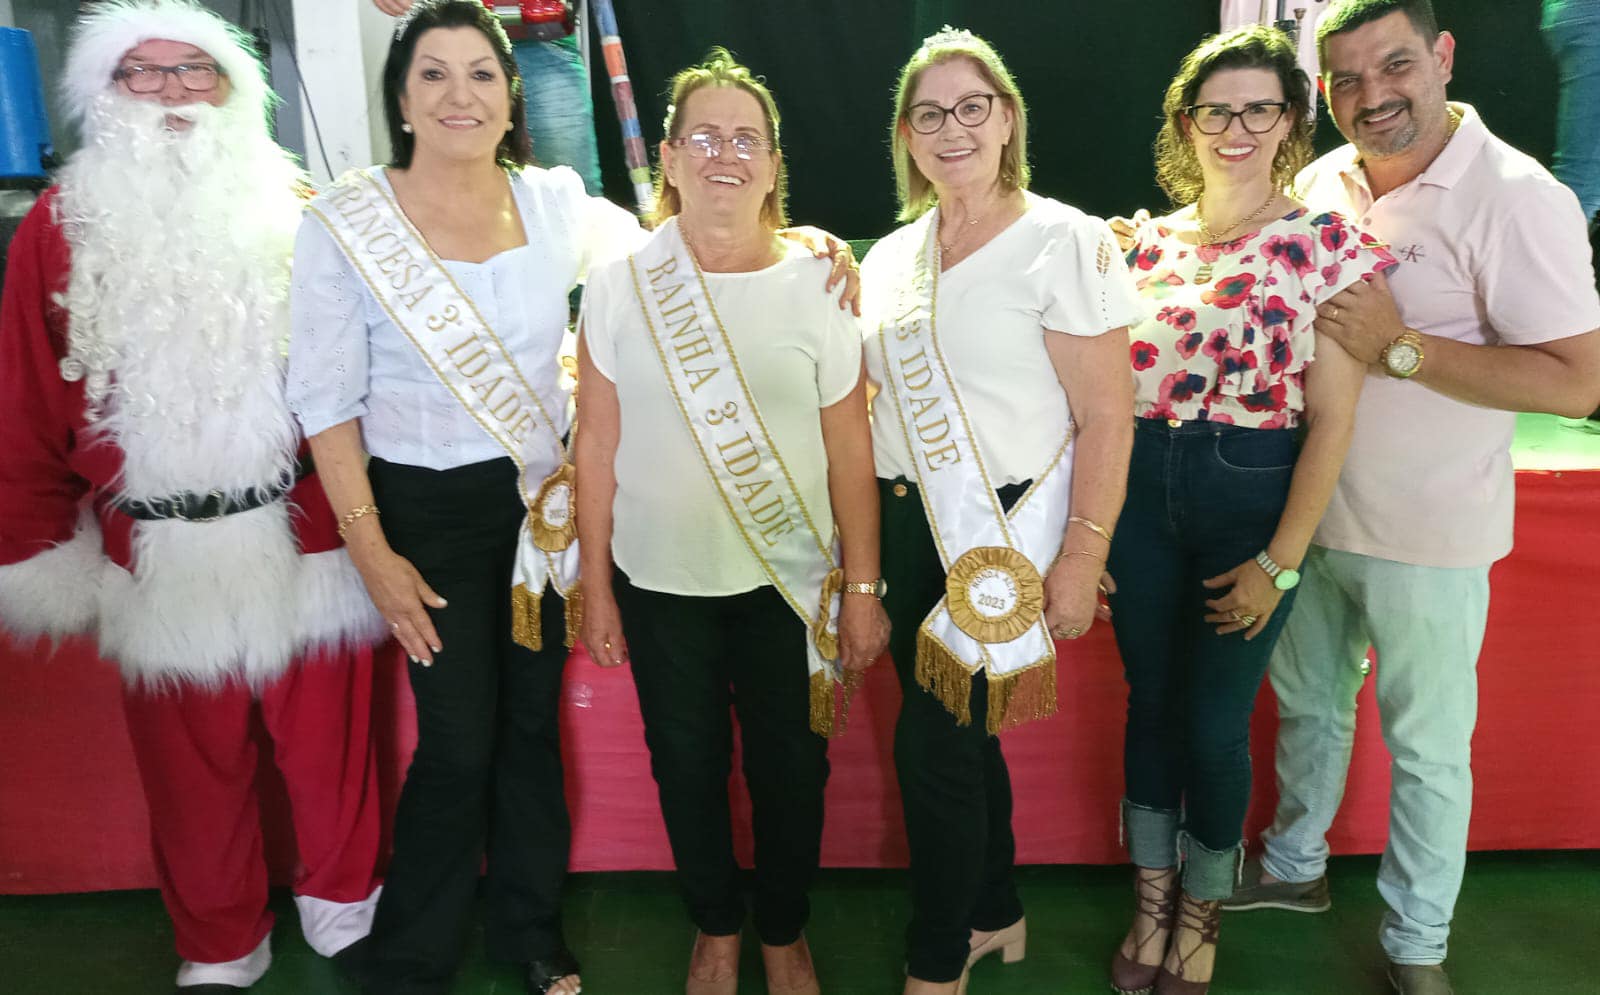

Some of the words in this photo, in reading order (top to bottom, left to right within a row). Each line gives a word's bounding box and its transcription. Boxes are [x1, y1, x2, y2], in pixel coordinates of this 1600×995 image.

[444, 331, 538, 444] IDADE
[646, 256, 721, 394] RAINHA
[716, 431, 796, 548] IDADE
[899, 345, 962, 472] IDADE
[977, 593, 1006, 610] 2023
